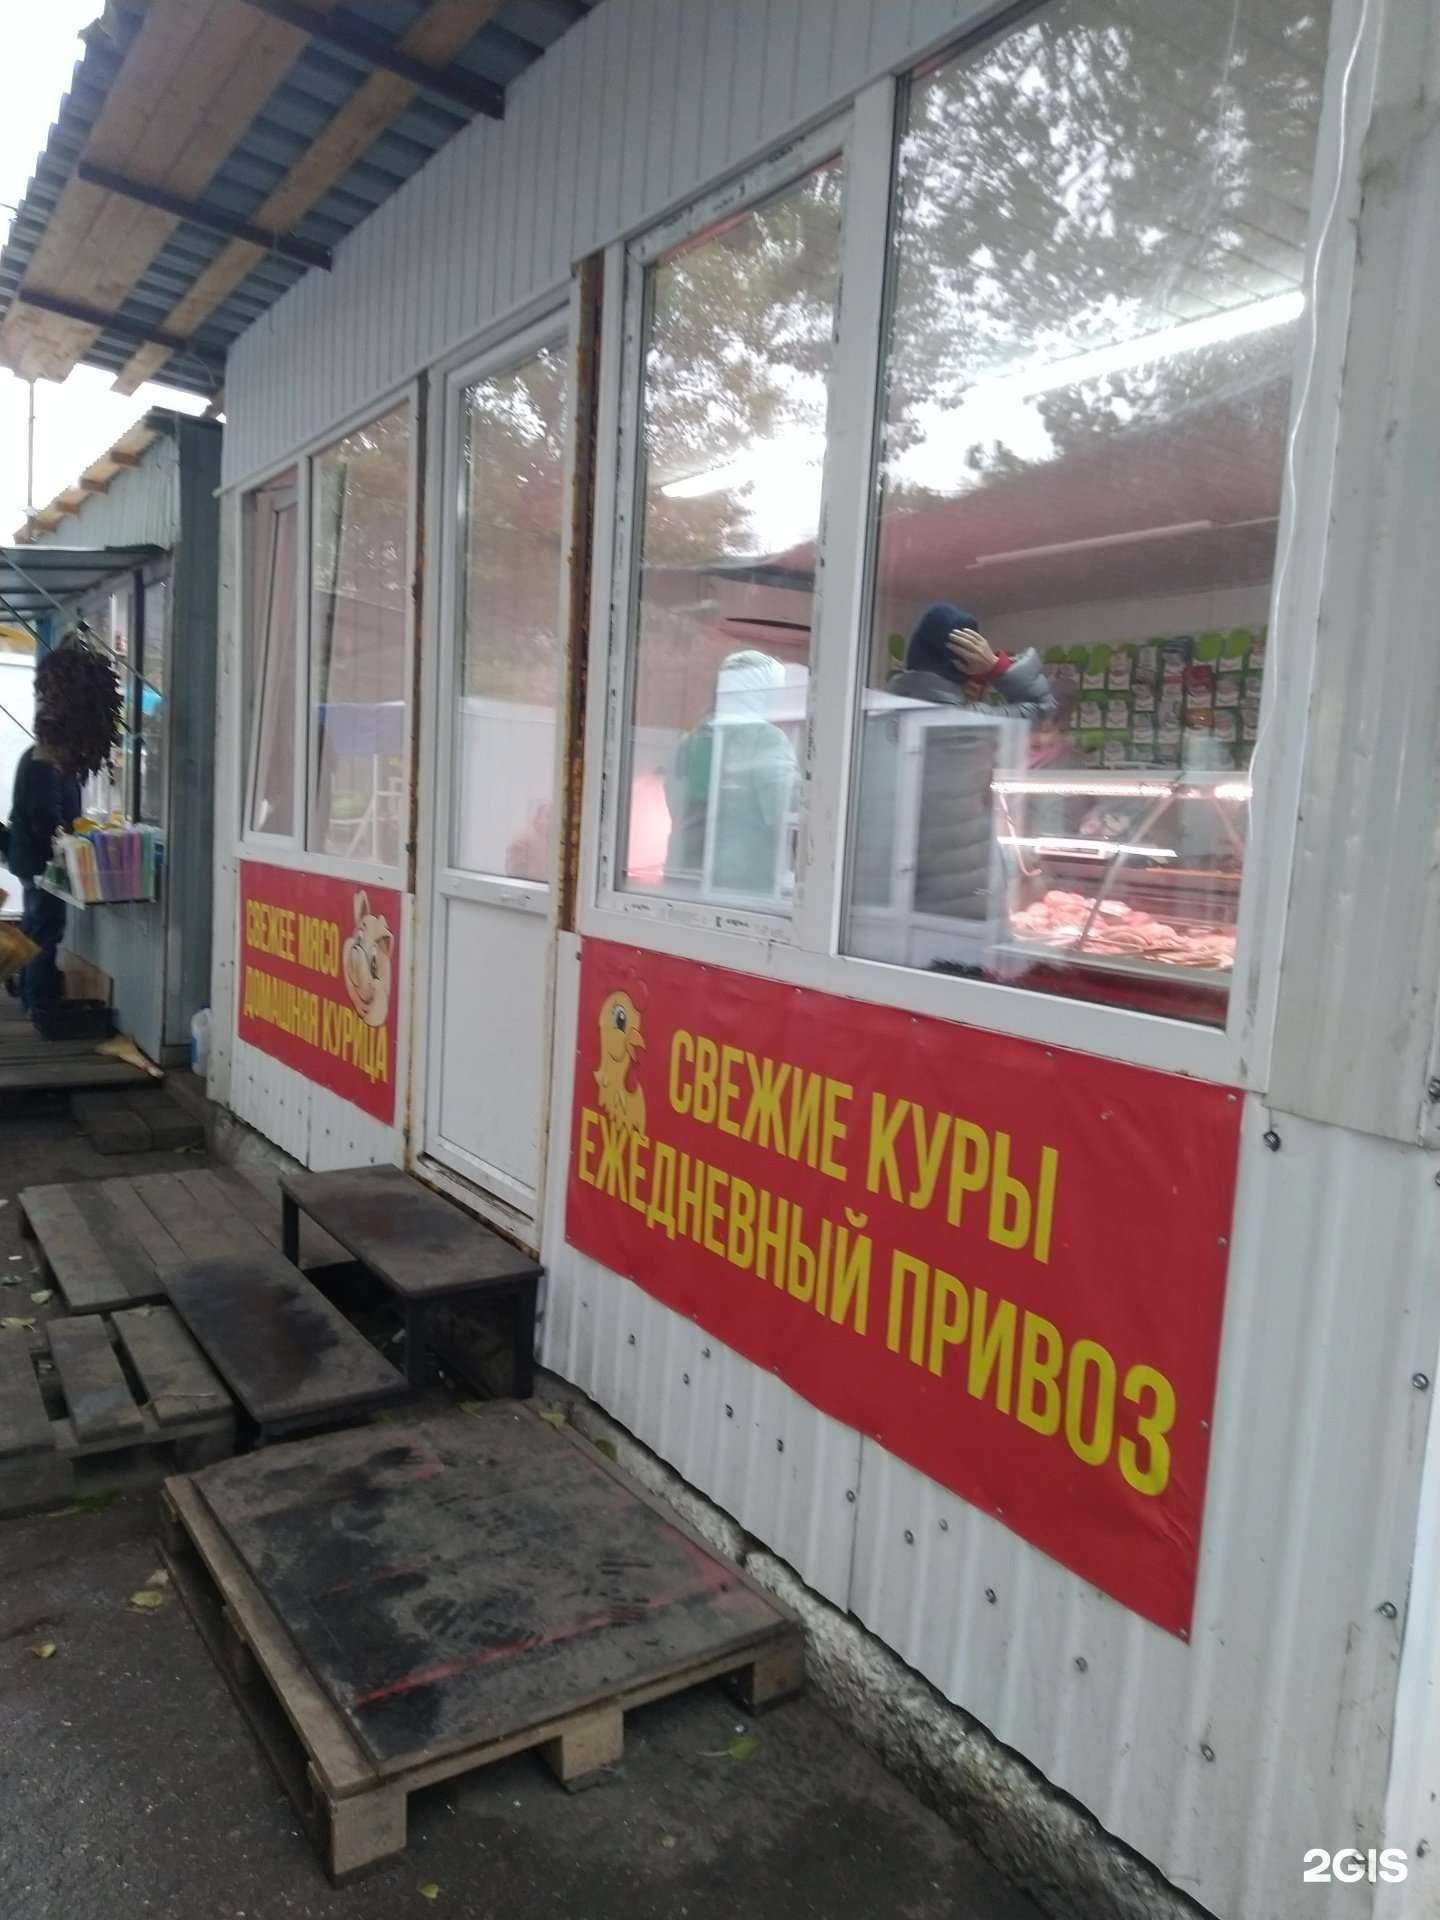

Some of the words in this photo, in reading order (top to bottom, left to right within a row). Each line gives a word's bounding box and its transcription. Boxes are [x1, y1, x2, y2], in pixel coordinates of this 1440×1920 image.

[246, 898, 296, 962] СВЕЖЕЕ
[299, 913, 339, 978] МЯСО
[322, 998, 388, 1084] КУРИЦА
[669, 1029, 853, 1182] СВЕЖИЕ
[866, 1092, 1059, 1265] КУРЫ
[577, 1107, 873, 1336] ЕЖЕДНЕВНЫЙ
[885, 1249, 1177, 1497] ПРИВОЗ
